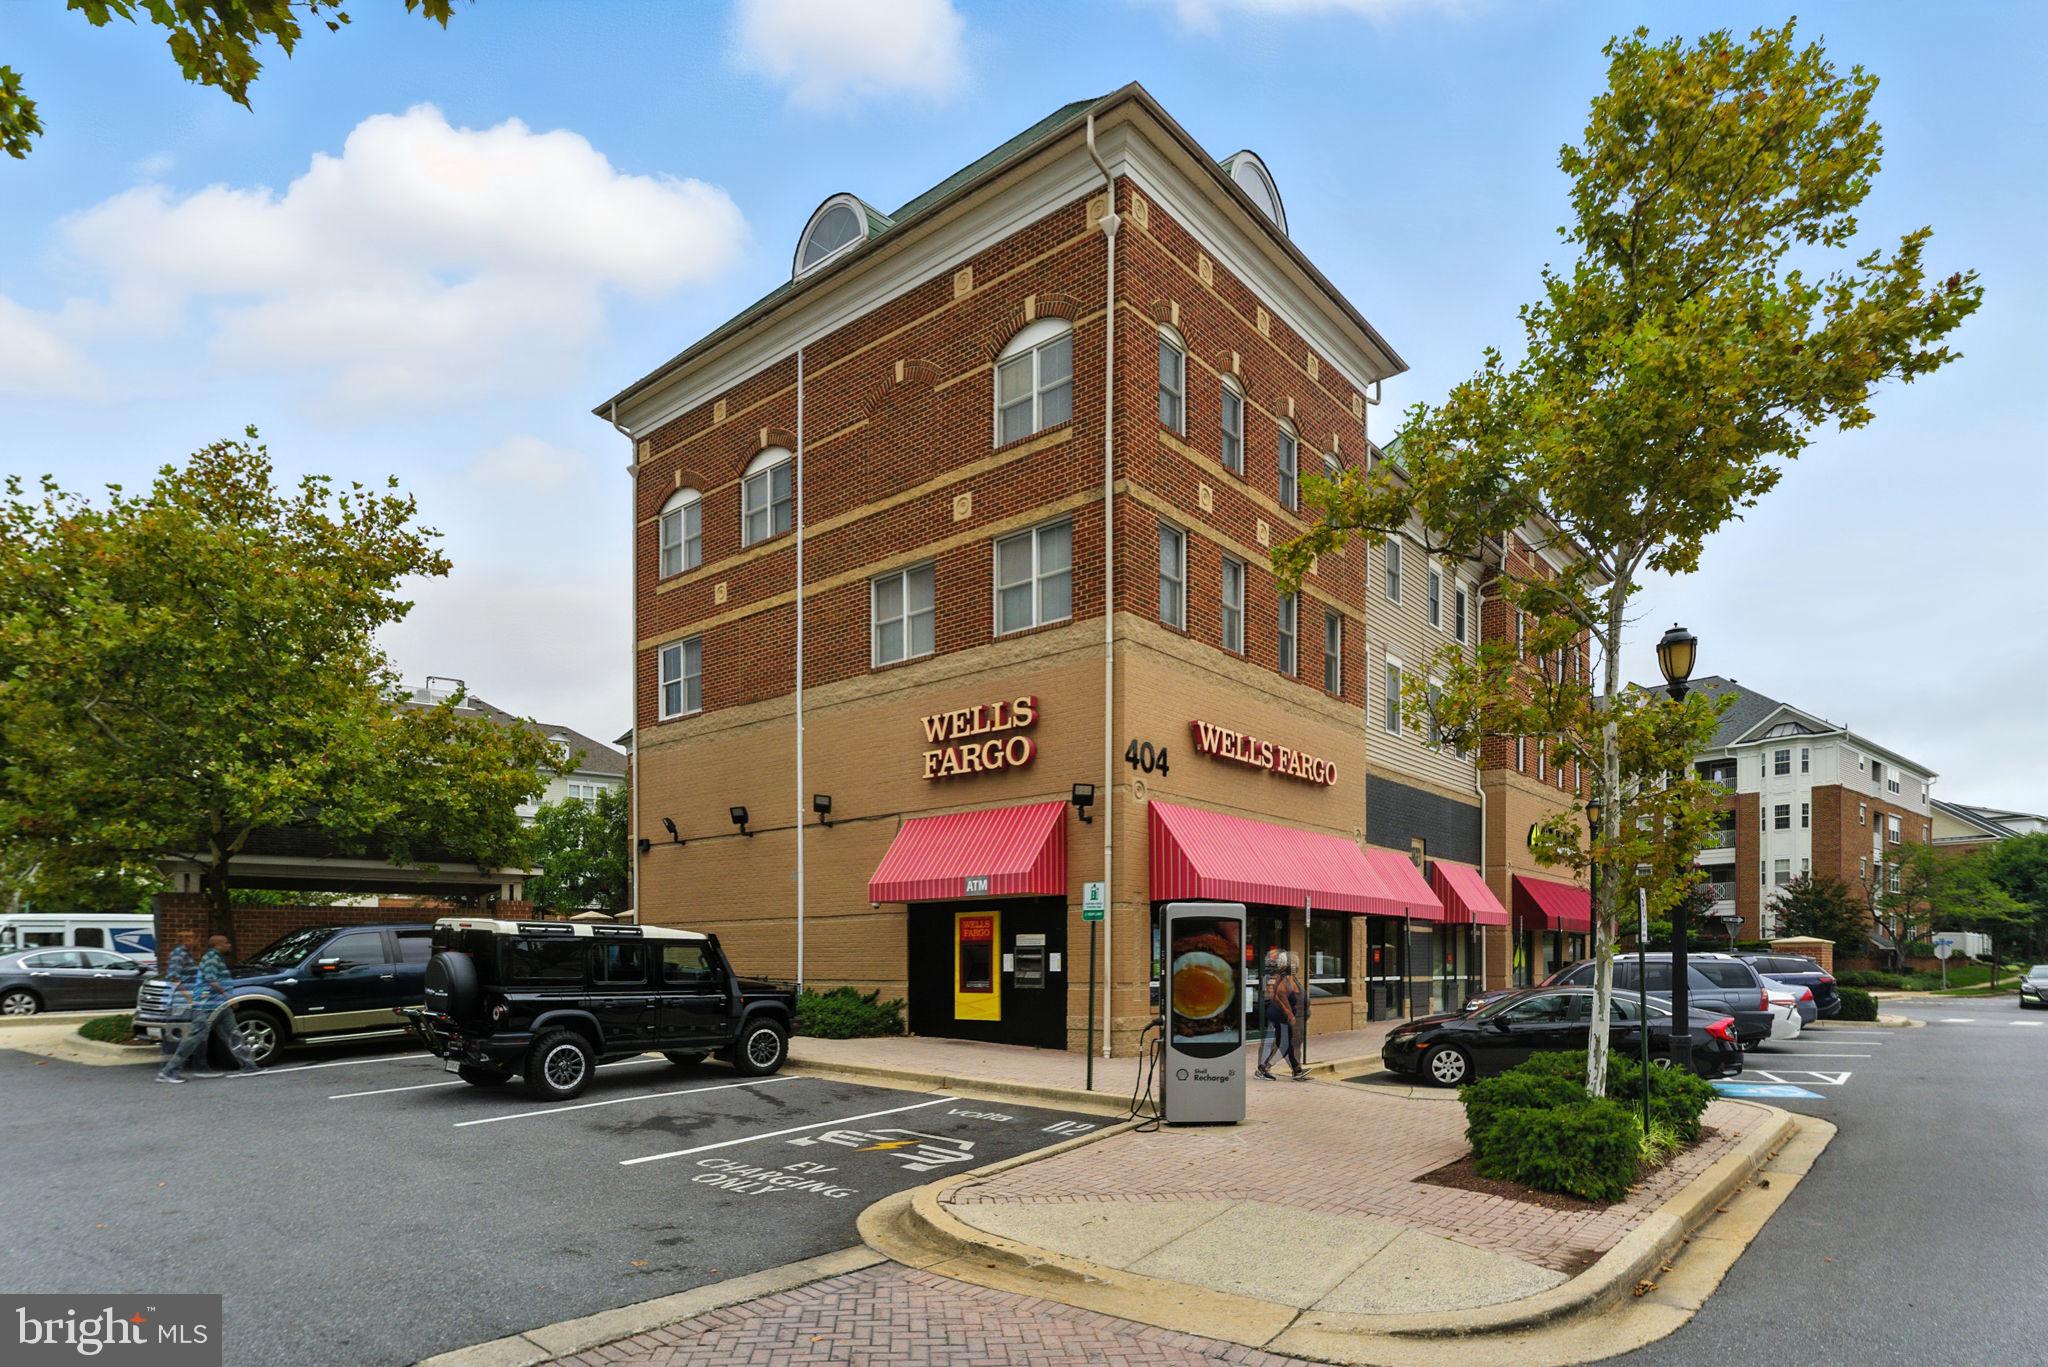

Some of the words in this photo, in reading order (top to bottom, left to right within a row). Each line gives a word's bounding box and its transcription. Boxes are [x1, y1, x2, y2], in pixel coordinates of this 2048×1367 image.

[920, 695, 1038, 743] WELLS
[921, 735, 1036, 779] FARGO
[1124, 738, 1169, 777] 404
[1195, 720, 1274, 769] WELLS
[1276, 744, 1338, 786] FARGO
[966, 878, 988, 892] ATM
[962, 919, 991, 929] WELLS
[963, 928, 991, 938] FARGO
[1193, 1074, 1229, 1083] Recharge
[696, 1158, 859, 1198] CHARGING
[783, 1161, 839, 1174] EV
[691, 1173, 787, 1195] ONLY
